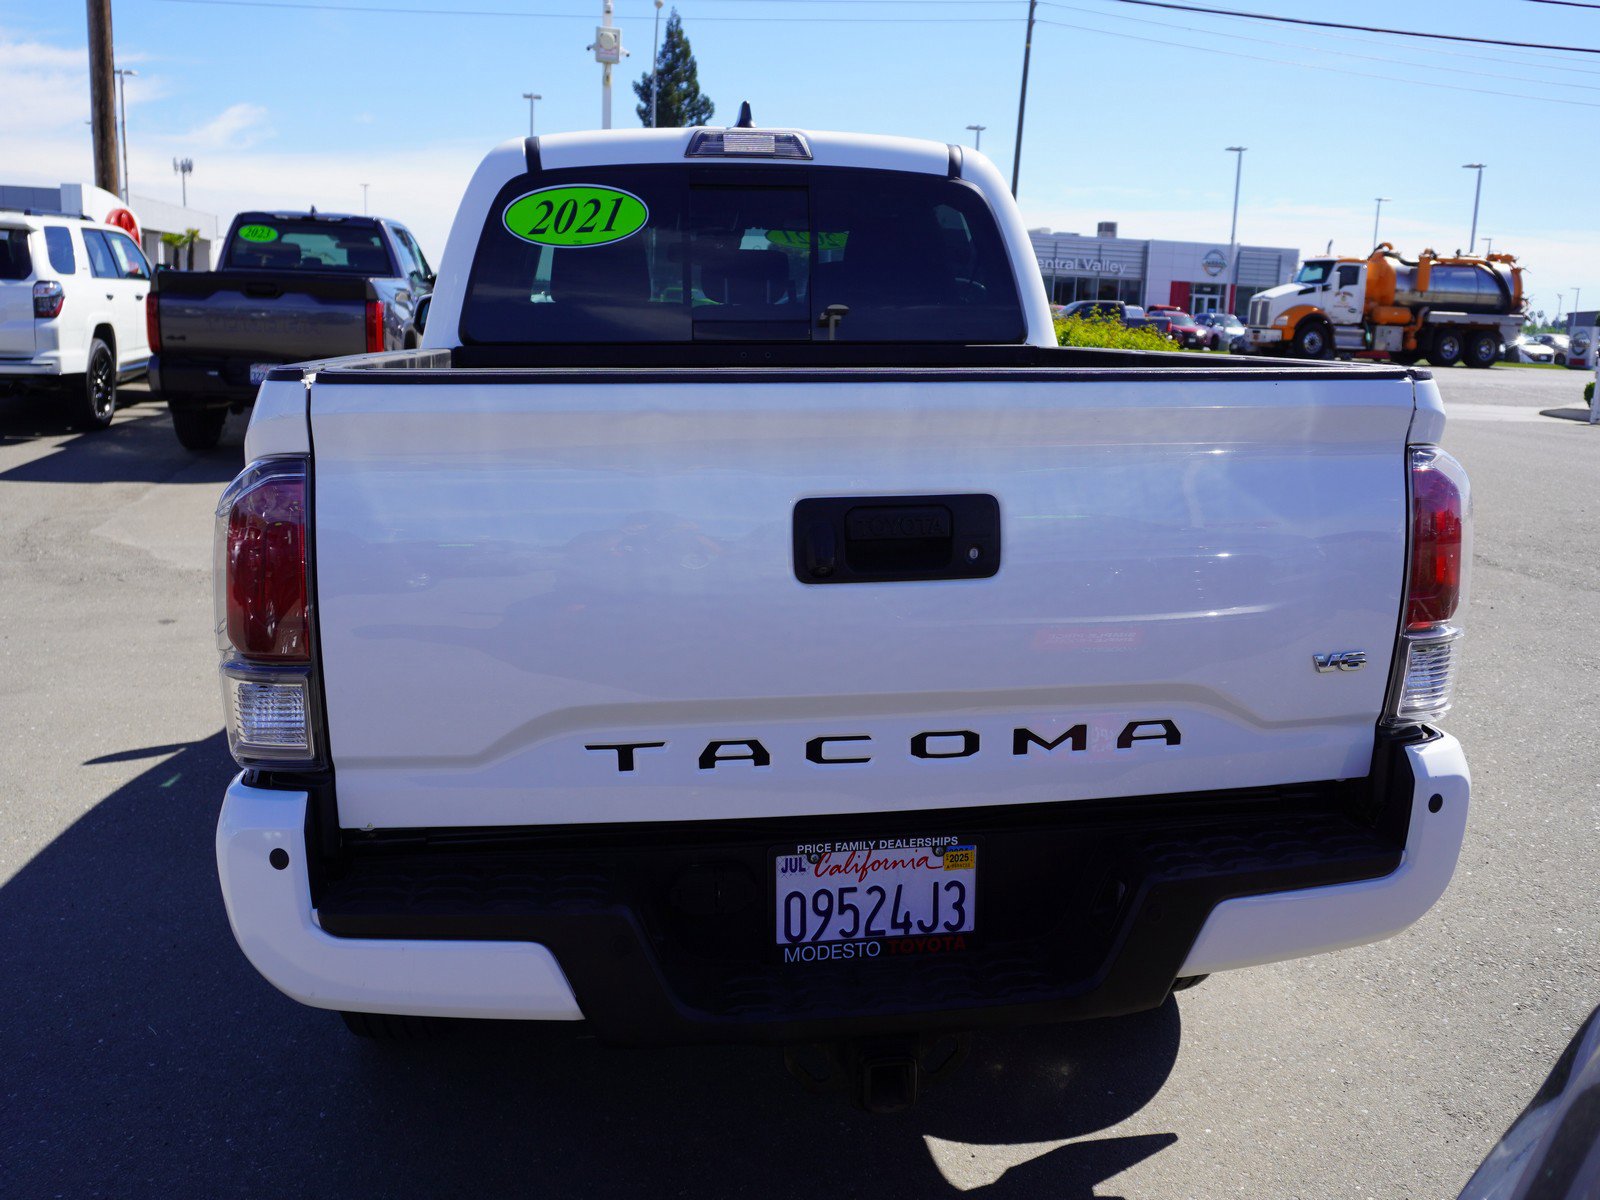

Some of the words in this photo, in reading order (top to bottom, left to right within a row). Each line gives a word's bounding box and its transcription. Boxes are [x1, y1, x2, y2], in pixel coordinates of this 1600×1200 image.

[528, 197, 624, 235] 2021
[1082, 258, 1127, 275] Valley
[856, 516, 945, 536] TOYOTA
[1312, 651, 1367, 673] V6
[584, 719, 1181, 771] TACOMA
[797, 843, 832, 854] PRICE
[835, 840, 875, 851] FAMILY
[879, 836, 959, 850] DEALERSHIPS
[780, 857, 806, 873] JUL
[814, 850, 943, 882] California
[949, 853, 969, 863] 2025
[784, 881, 966, 943] 09524J3
[784, 941, 881, 963] MODESTO
[888, 935, 966, 955] TOYOTA
